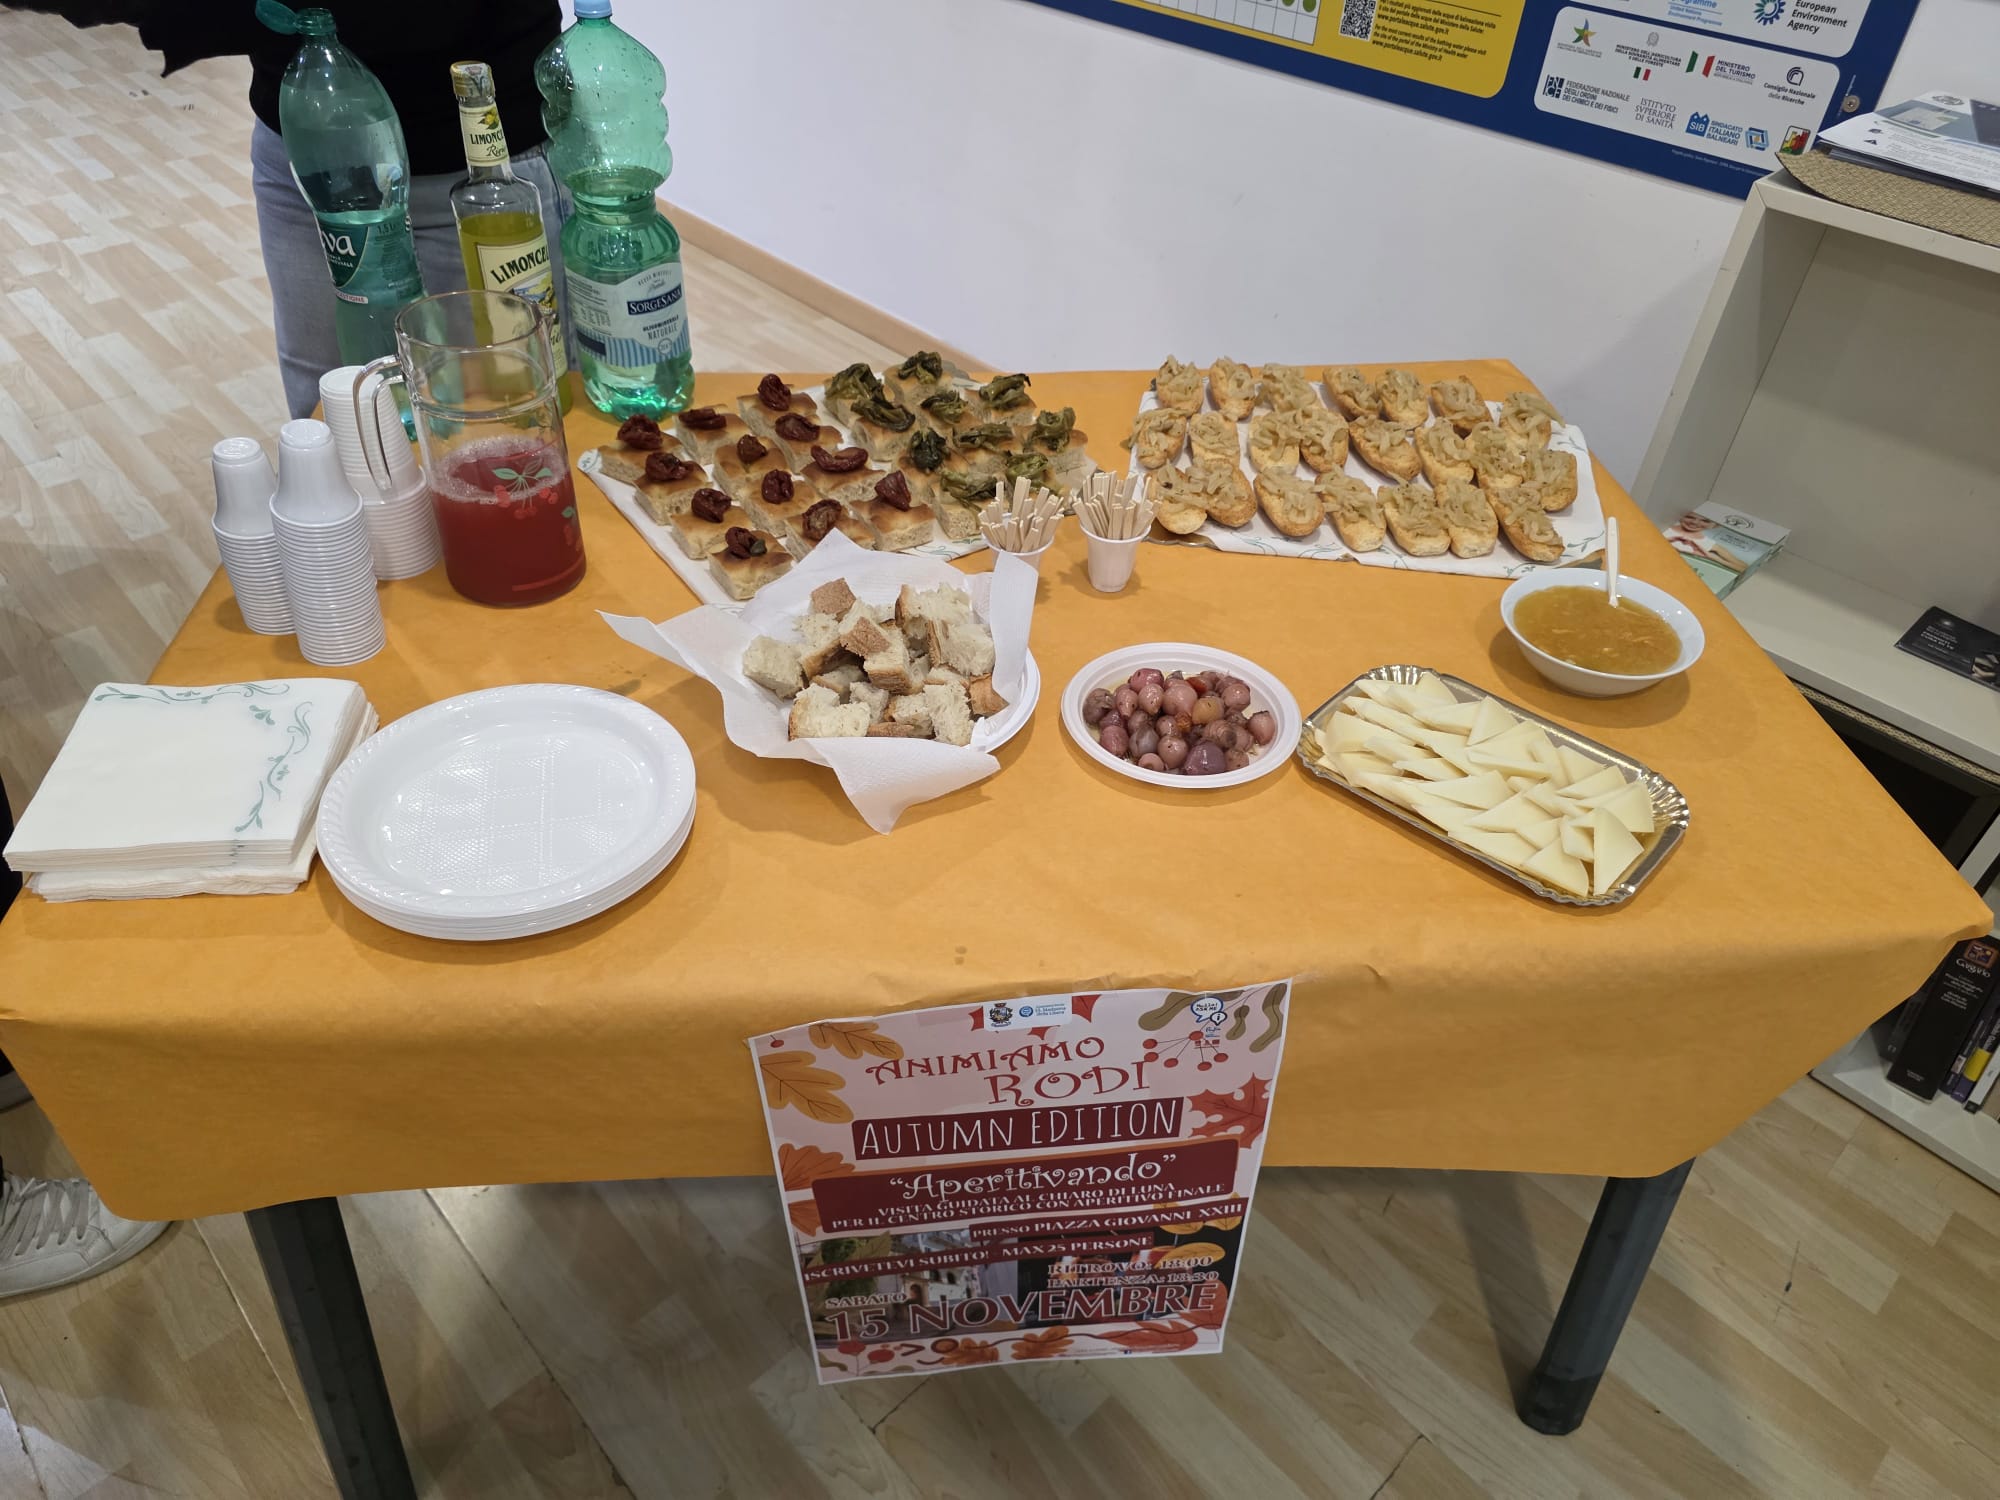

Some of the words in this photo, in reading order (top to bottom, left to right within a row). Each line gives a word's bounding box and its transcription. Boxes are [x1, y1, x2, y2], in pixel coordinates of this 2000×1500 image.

[1795, 0, 1837, 14] European
[1786, 20, 1820, 35] Agency
[1792, 9, 1848, 28] Environment
[1715, 65, 1728, 74] DEL
[1728, 68, 1756, 80] TURISMO
[1717, 59, 1751, 72] MINISTERO
[1564, 87, 1579, 97] DEGLI
[1579, 91, 1598, 100] ORDINI
[1566, 80, 1601, 95] FEDERAZIONE
[1601, 88, 1631, 102] NAZIONALE
[1764, 82, 1789, 94] Consiglio
[1789, 86, 1816, 100] Nazionale
[1781, 94, 1805, 106] Ricerche
[1562, 94, 1571, 102] DEI
[1571, 96, 1590, 108] CHIMICI
[1594, 102, 1604, 110] DEI
[1604, 104, 1619, 114] FISICI
[1634, 113, 1645, 121] DI
[1710, 120, 1743, 132] SINDACATO
[1689, 122, 1705, 132] SIB
[1708, 126, 1741, 140] ITALIANO
[1706, 132, 1738, 146] BALNEARI
[629, 288, 682, 314] SORGESANA
[865, 1036, 1105, 1086] ANIMIAMO
[984, 1060, 1150, 1106] RODI
[861, 1116, 1014, 1156] AUTUMN
[1031, 1100, 1177, 1144] EDITION
[832, 1218, 864, 1230] PER
[868, 1216, 883, 1226] IL
[888, 1210, 955, 1224] CENTRO
[958, 1203, 1032, 1217] STORICO
[1036, 1199, 1070, 1210] CON
[1072, 1192, 1164, 1208] APERITIVO
[1168, 1183, 1226, 1200] FINALE
[878, 1203, 933, 1217] VISITA
[936, 1196, 1014, 1211] GUIDATA
[1014, 1194, 1030, 1204] AL
[1038, 1189, 1104, 1202] CHIARO
[1108, 1186, 1127, 1196] DI
[1132, 1182, 1176, 1195] LUNA
[972, 1224, 1030, 1239] PRESSO
[1034, 1218, 1100, 1232] PIAZZA
[1104, 1210, 1192, 1228] GIOVANNI
[1198, 1203, 1243, 1218] XXIII
[804, 1260, 915, 1282] ISCRIVETEVI
[918, 1250, 990, 1266] SUBITO!
[1002, 1244, 1044, 1257] MAX
[1048, 1242, 1067, 1252] 25
[1070, 1236, 1153, 1251] PERSONE
[1048, 1260, 1154, 1276] RITROVO:
[1158, 1255, 1214, 1271] 18:00
[1047, 1272, 1164, 1289] PARTENZA:
[1166, 1270, 1220, 1284] 18:30
[825, 1291, 908, 1310] SABATO
[824, 1306, 890, 1342] 15
[909, 1283, 1220, 1335] NOVEMBRE
